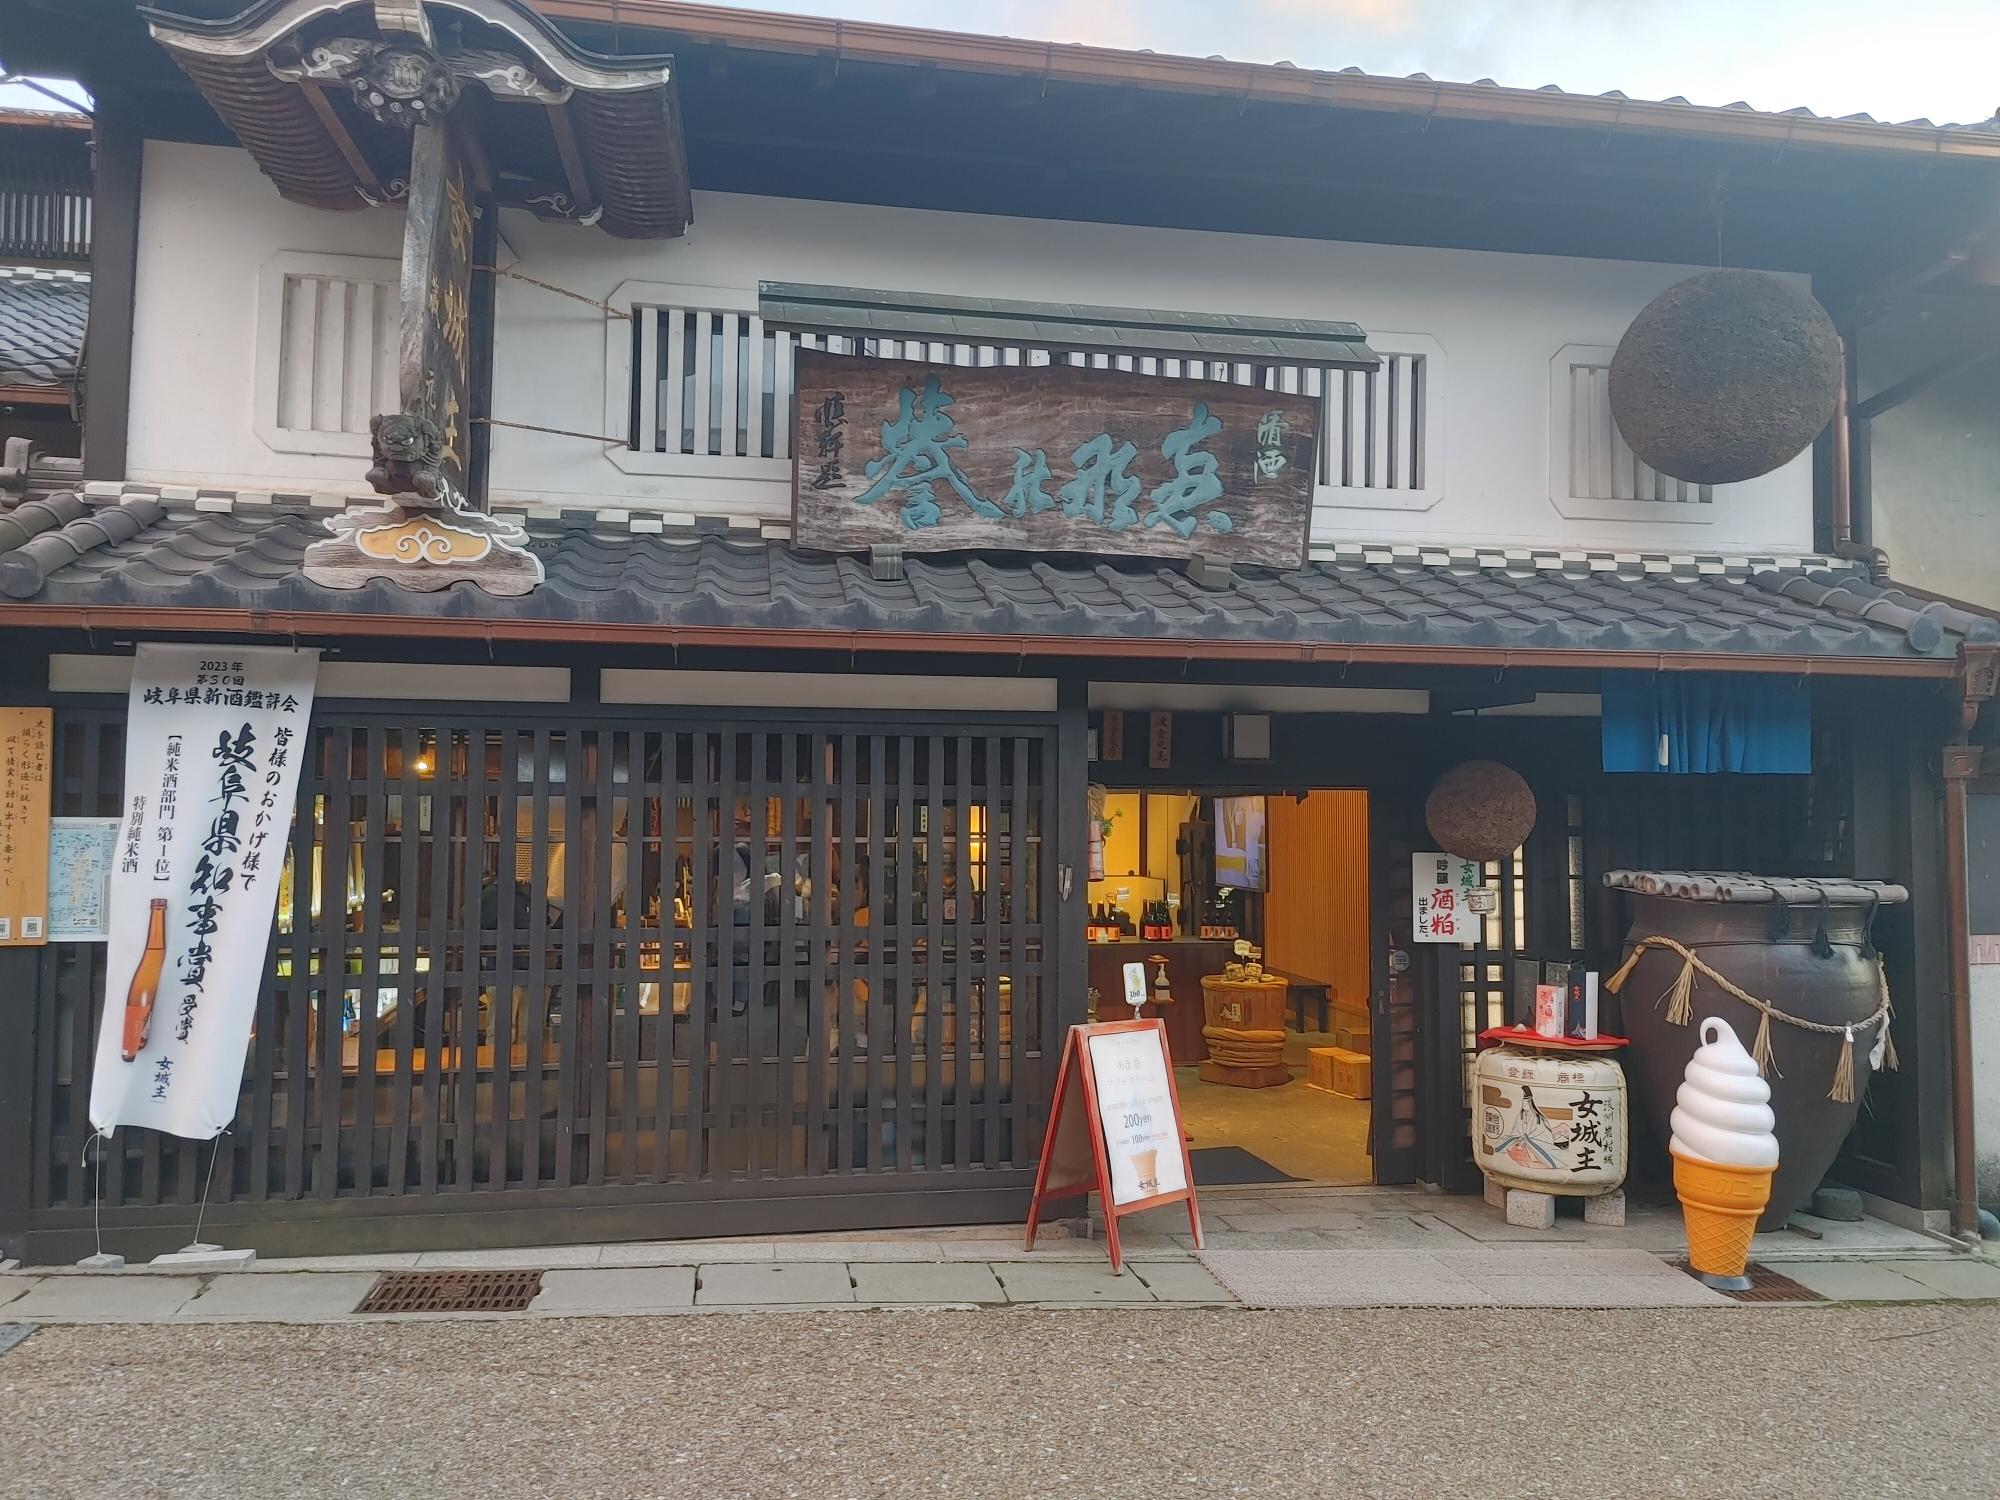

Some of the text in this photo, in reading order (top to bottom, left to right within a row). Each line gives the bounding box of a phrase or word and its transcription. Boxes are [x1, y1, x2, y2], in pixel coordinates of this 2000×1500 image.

[1254, 409, 1289, 484] 清酒
[144, 687, 299, 713] 岐阜県新酒鑑評会
[197, 674, 244, 686] 第30回
[240, 726, 293, 891] 皆様のおかげ様で
[122, 795, 147, 873] 特別純米酒
[1436, 853, 1448, 884] 吟醸
[1418, 897, 1429, 937] 出ました。
[1431, 888, 1455, 935] 酒粕
[152, 1055, 174, 1100] 女城主
[1569, 1090, 1603, 1173] 女城主
